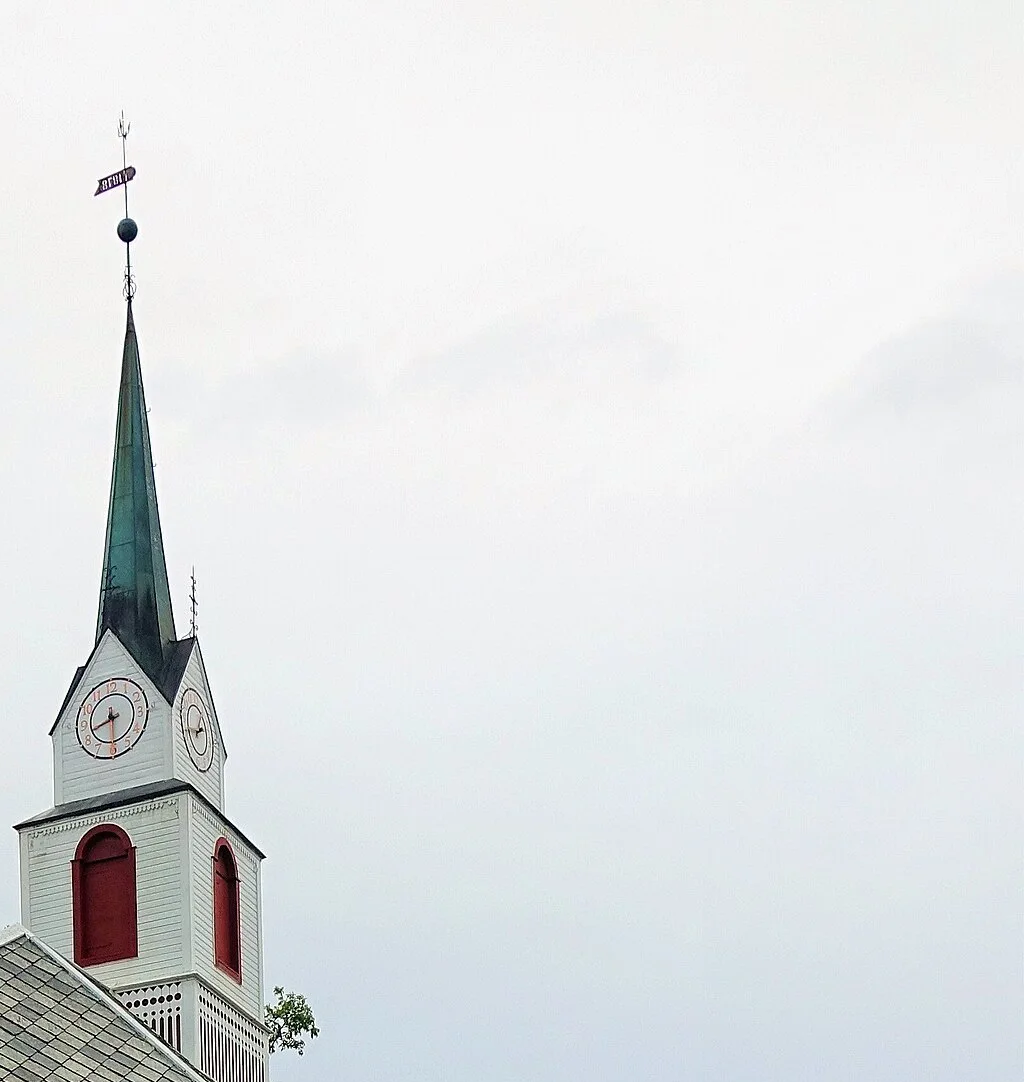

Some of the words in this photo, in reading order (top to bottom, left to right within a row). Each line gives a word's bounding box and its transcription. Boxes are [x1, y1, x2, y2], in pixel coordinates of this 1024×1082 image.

[105, 681, 118, 693] 12
[92, 690, 102, 701] 11
[132, 692, 141, 704] 2
[82, 703, 93, 715] 10
[136, 705, 144, 717] 3
[80, 720, 88, 731] 9
[132, 721, 140, 734] 4
[85, 735, 92, 746] 8
[124, 735, 132, 747] 5
[94, 743, 102, 755] 7
[109, 743, 117, 755] 6
